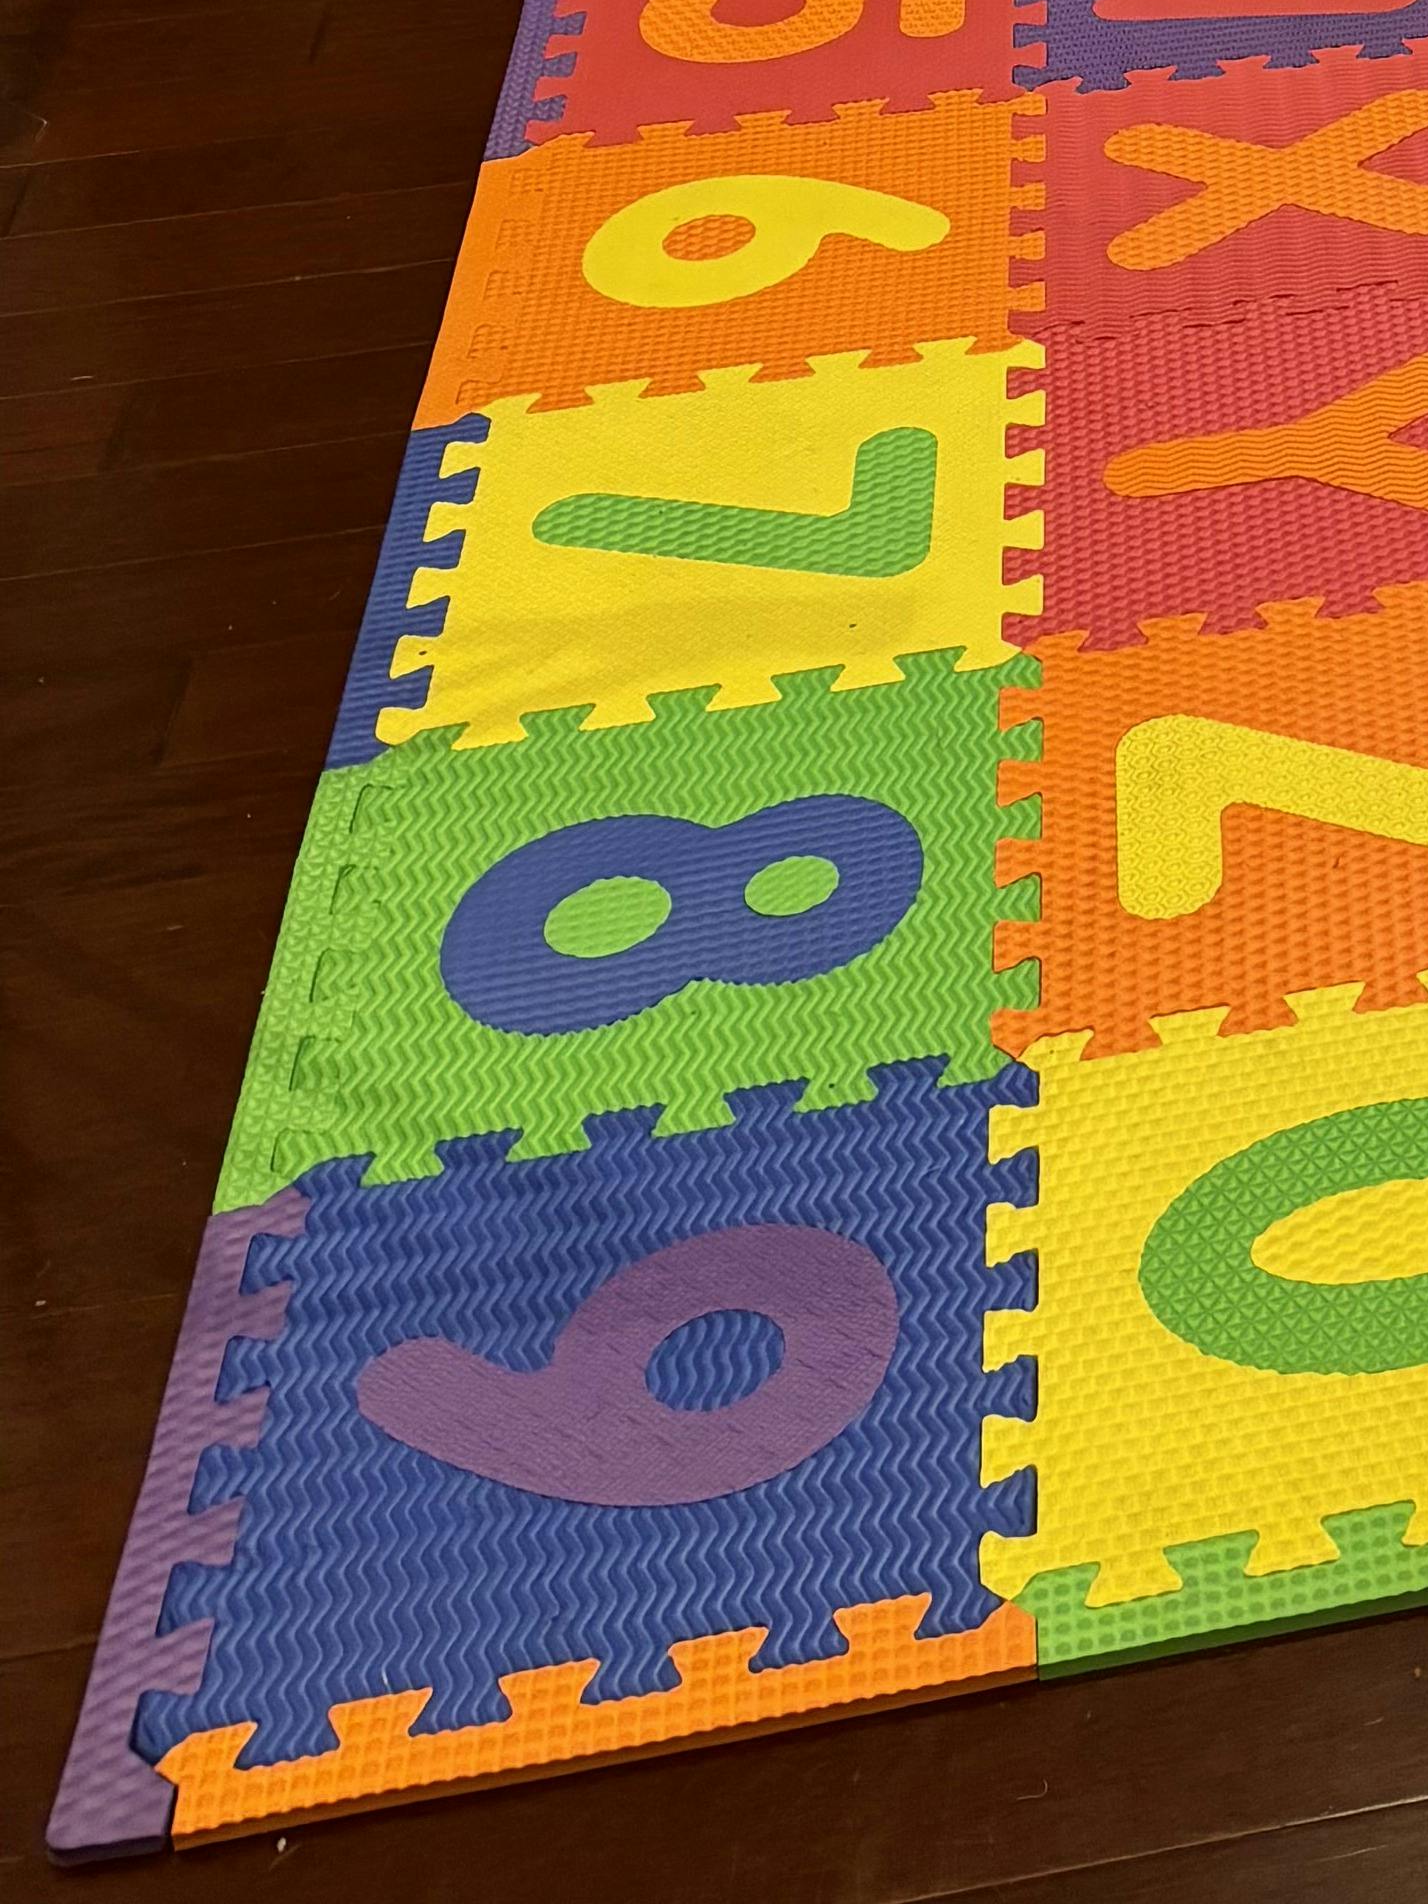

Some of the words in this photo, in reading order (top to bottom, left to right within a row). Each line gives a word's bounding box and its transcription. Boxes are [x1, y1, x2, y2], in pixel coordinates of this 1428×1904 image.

[581, 173, 952, 306] 6
[531, 425, 940, 578] 7
[437, 792, 926, 1037] 8
[353, 1221, 902, 1507] 9
